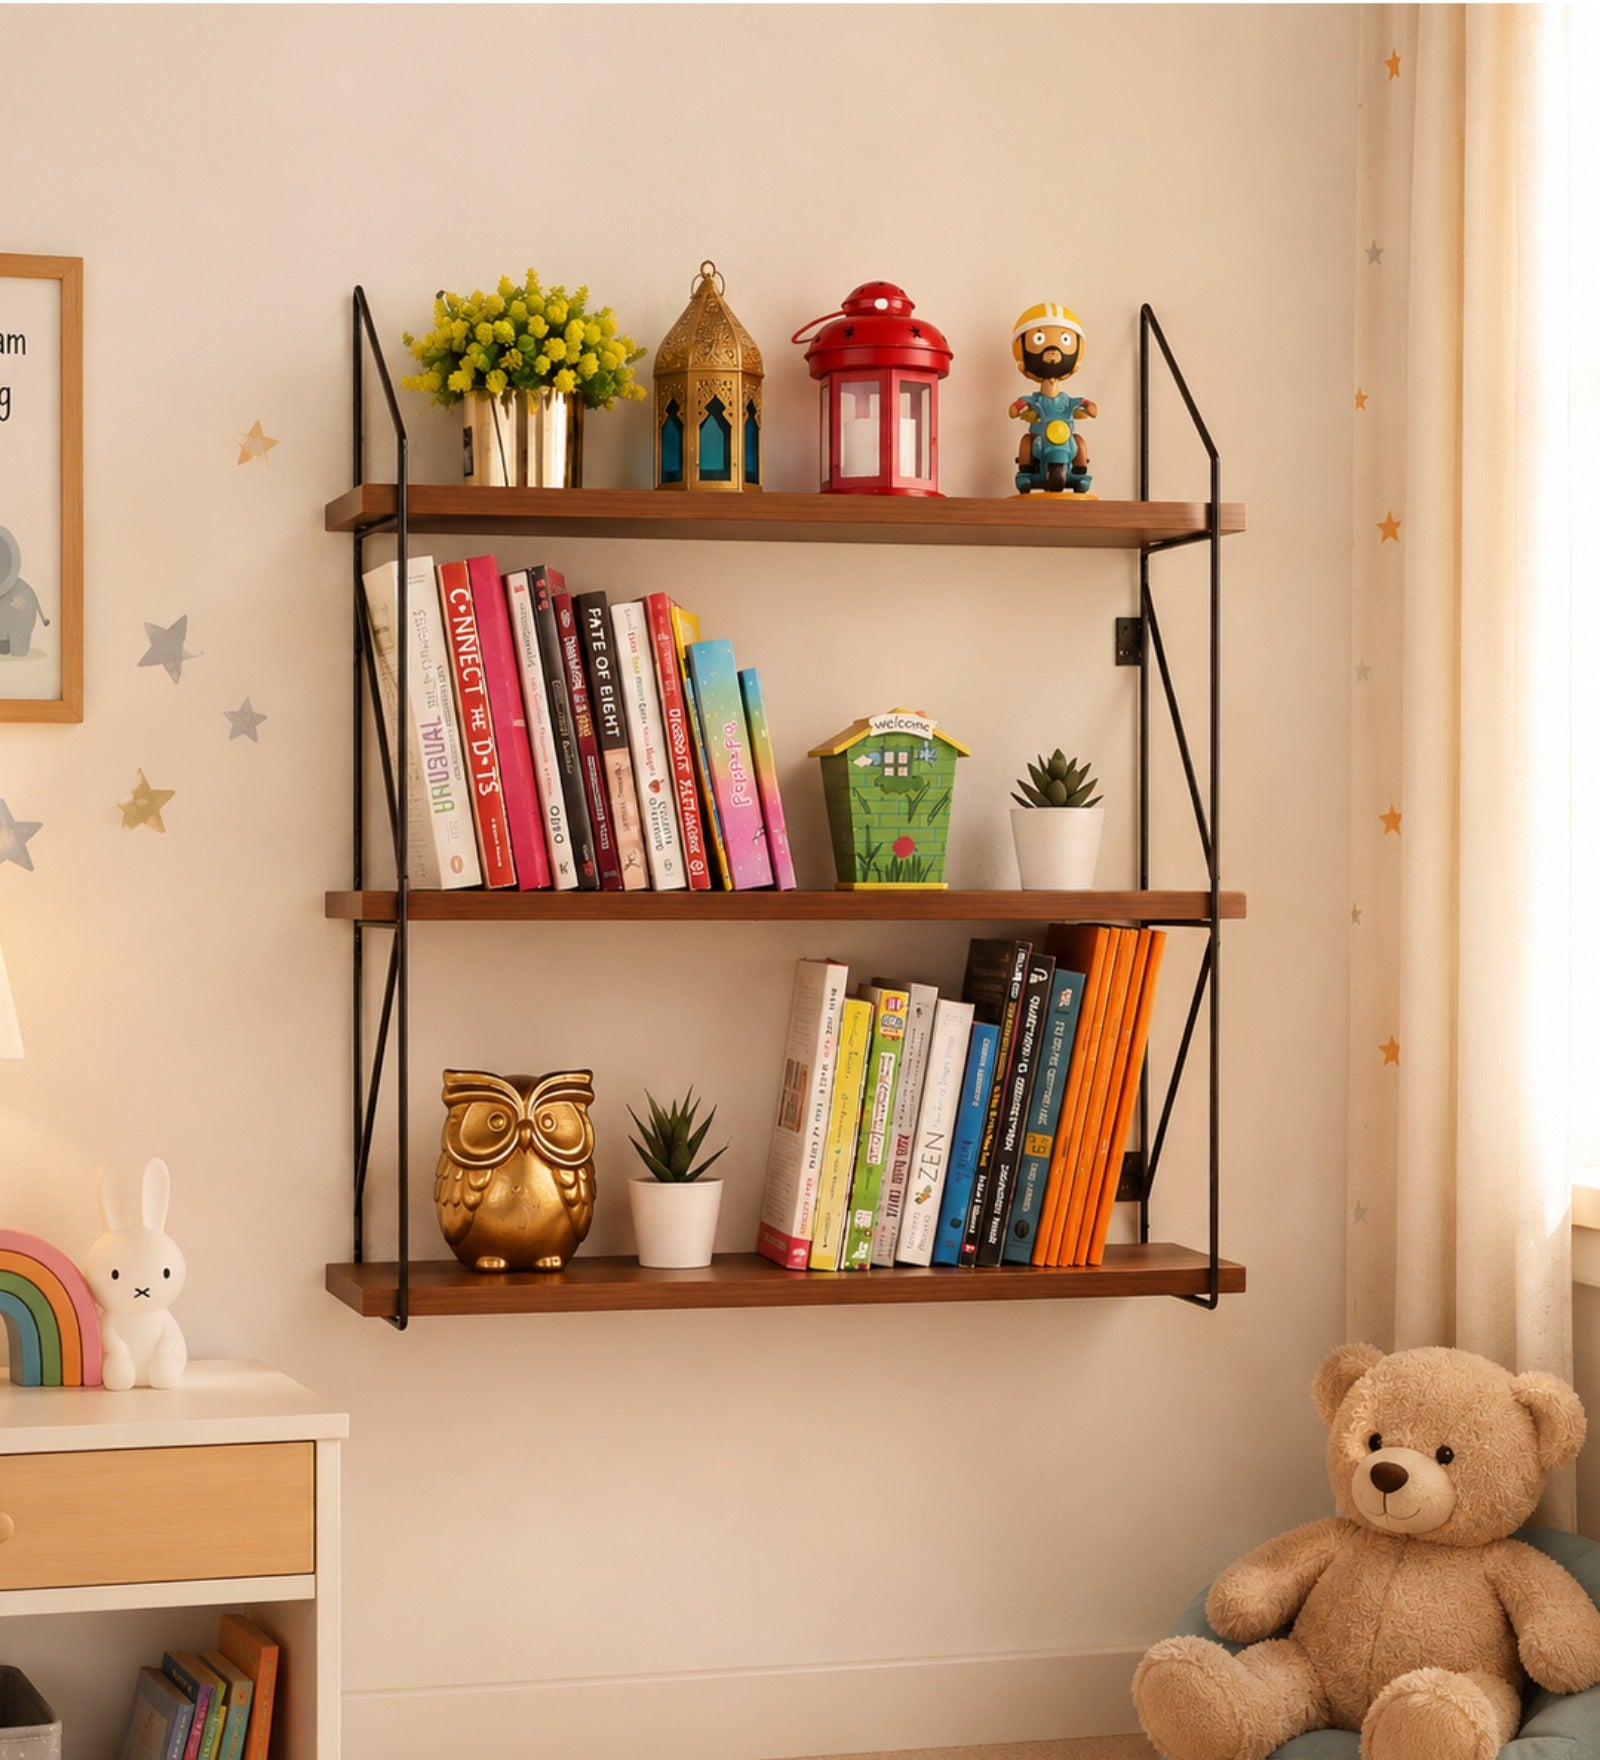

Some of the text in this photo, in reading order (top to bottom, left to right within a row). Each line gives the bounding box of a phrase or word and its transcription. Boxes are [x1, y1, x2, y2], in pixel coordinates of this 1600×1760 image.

[450, 588, 499, 797] CNNECT THE DTS
[595, 655, 610, 680] OF
[600, 685, 620, 738] EIGHT
[874, 716, 931, 732] welcome
[917, 1130, 946, 1183] ZEN
